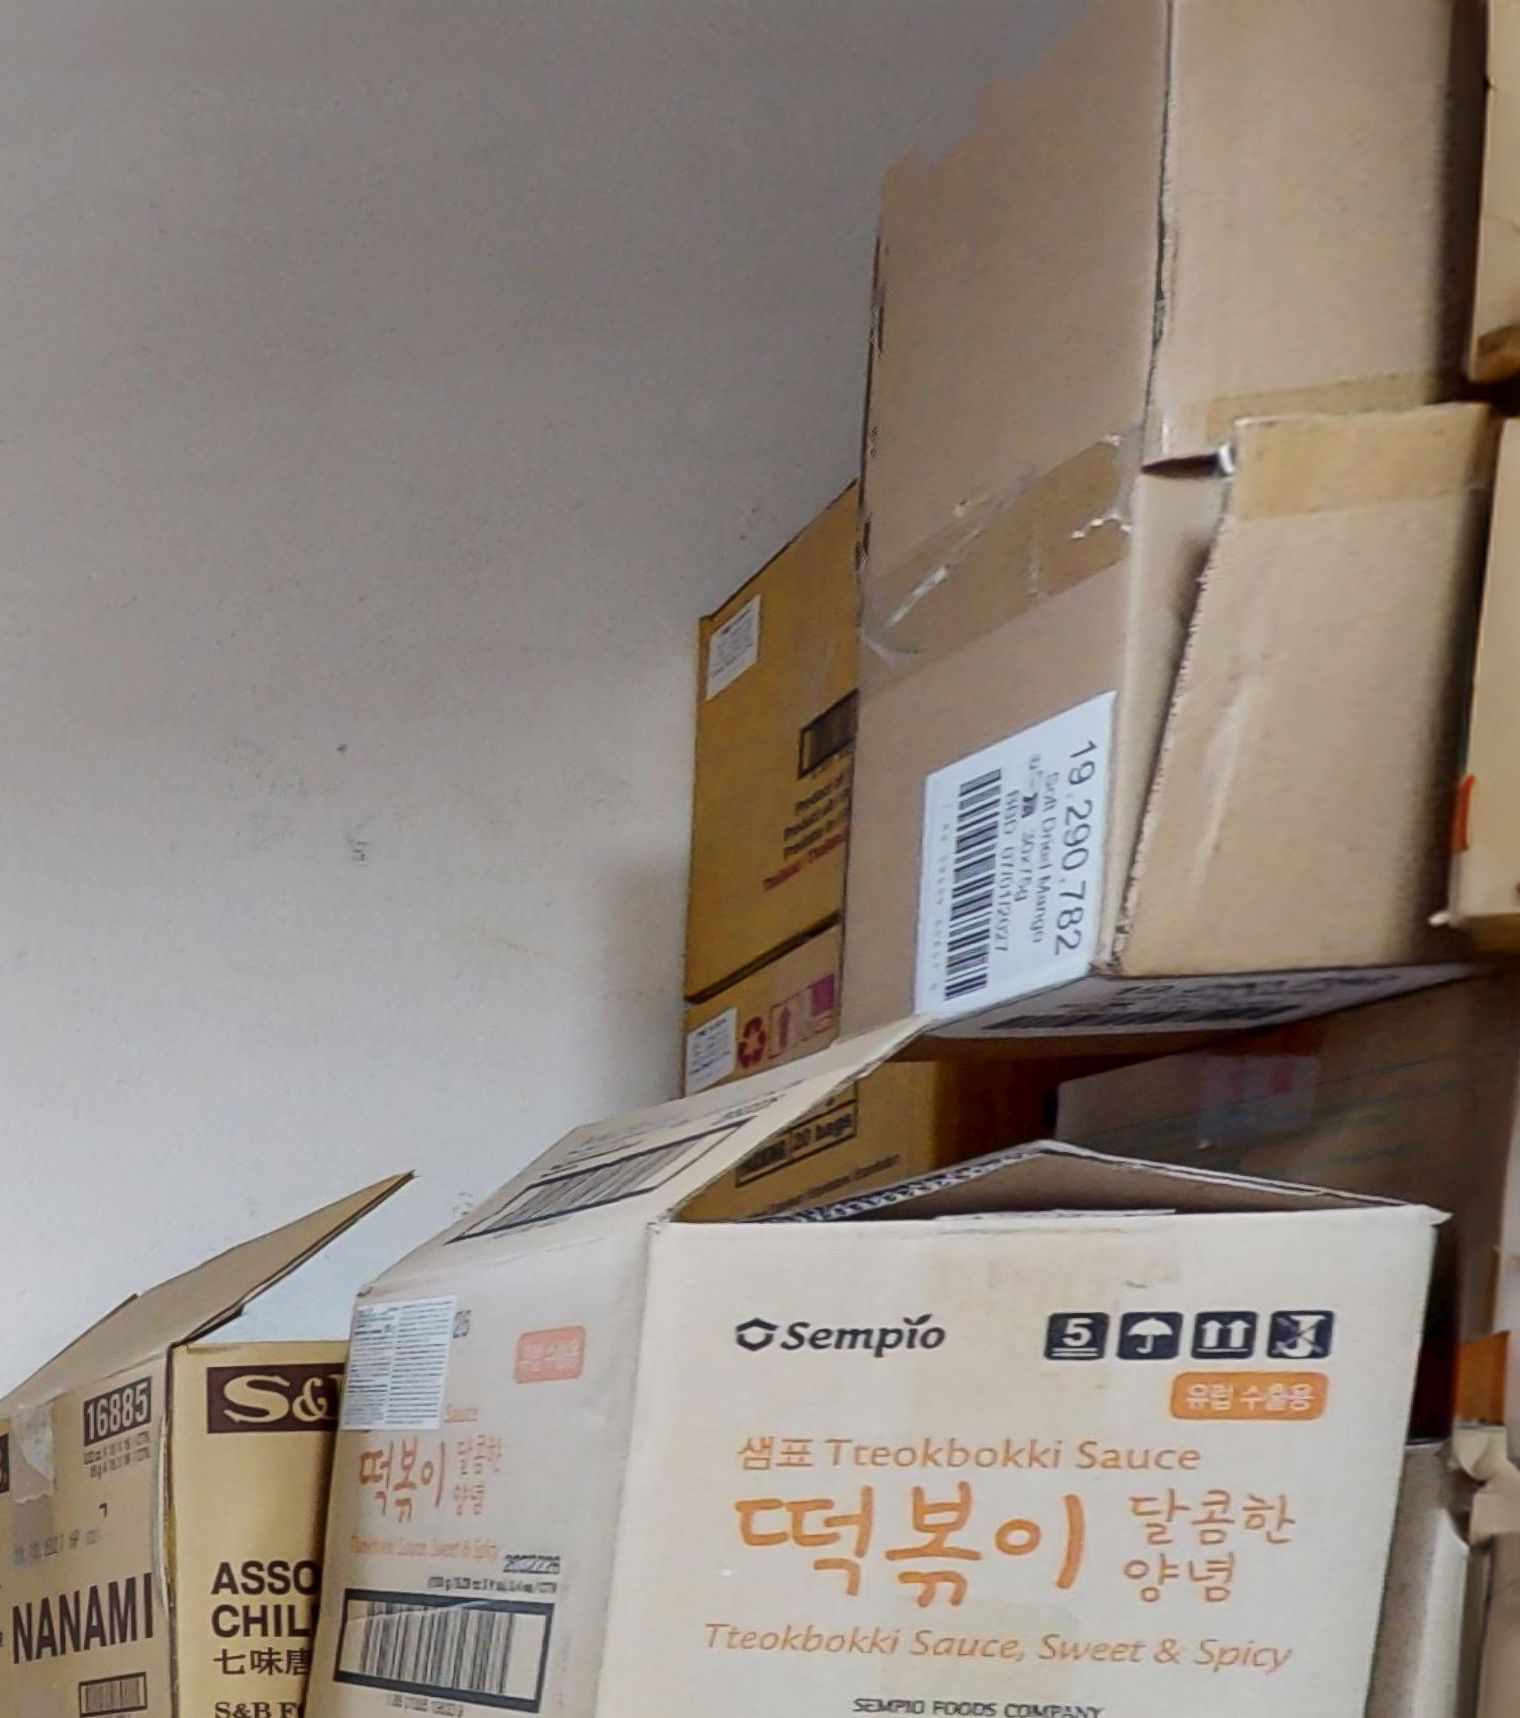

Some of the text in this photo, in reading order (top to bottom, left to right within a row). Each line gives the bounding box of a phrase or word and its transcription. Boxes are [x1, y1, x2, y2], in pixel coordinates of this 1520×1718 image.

[780, 1315, 945, 1360] Sempio
[87, 1380, 149, 1445] 16885
[223, 1374, 344, 1423] S&
[738, 1437, 1201, 1471] 샘표 Tteokbokki Sauce
[1129, 1487, 1296, 1546] 달콤한
[735, 1482, 1084, 1608] 떡볶이
[1124, 1553, 1236, 1602] 양념
[13, 1573, 153, 1664] NANAMI
[705, 1623, 1291, 1672] Tteokbokki Sauce, Sweet & Spicy
[932, 1700, 997, 1718] FOODS
